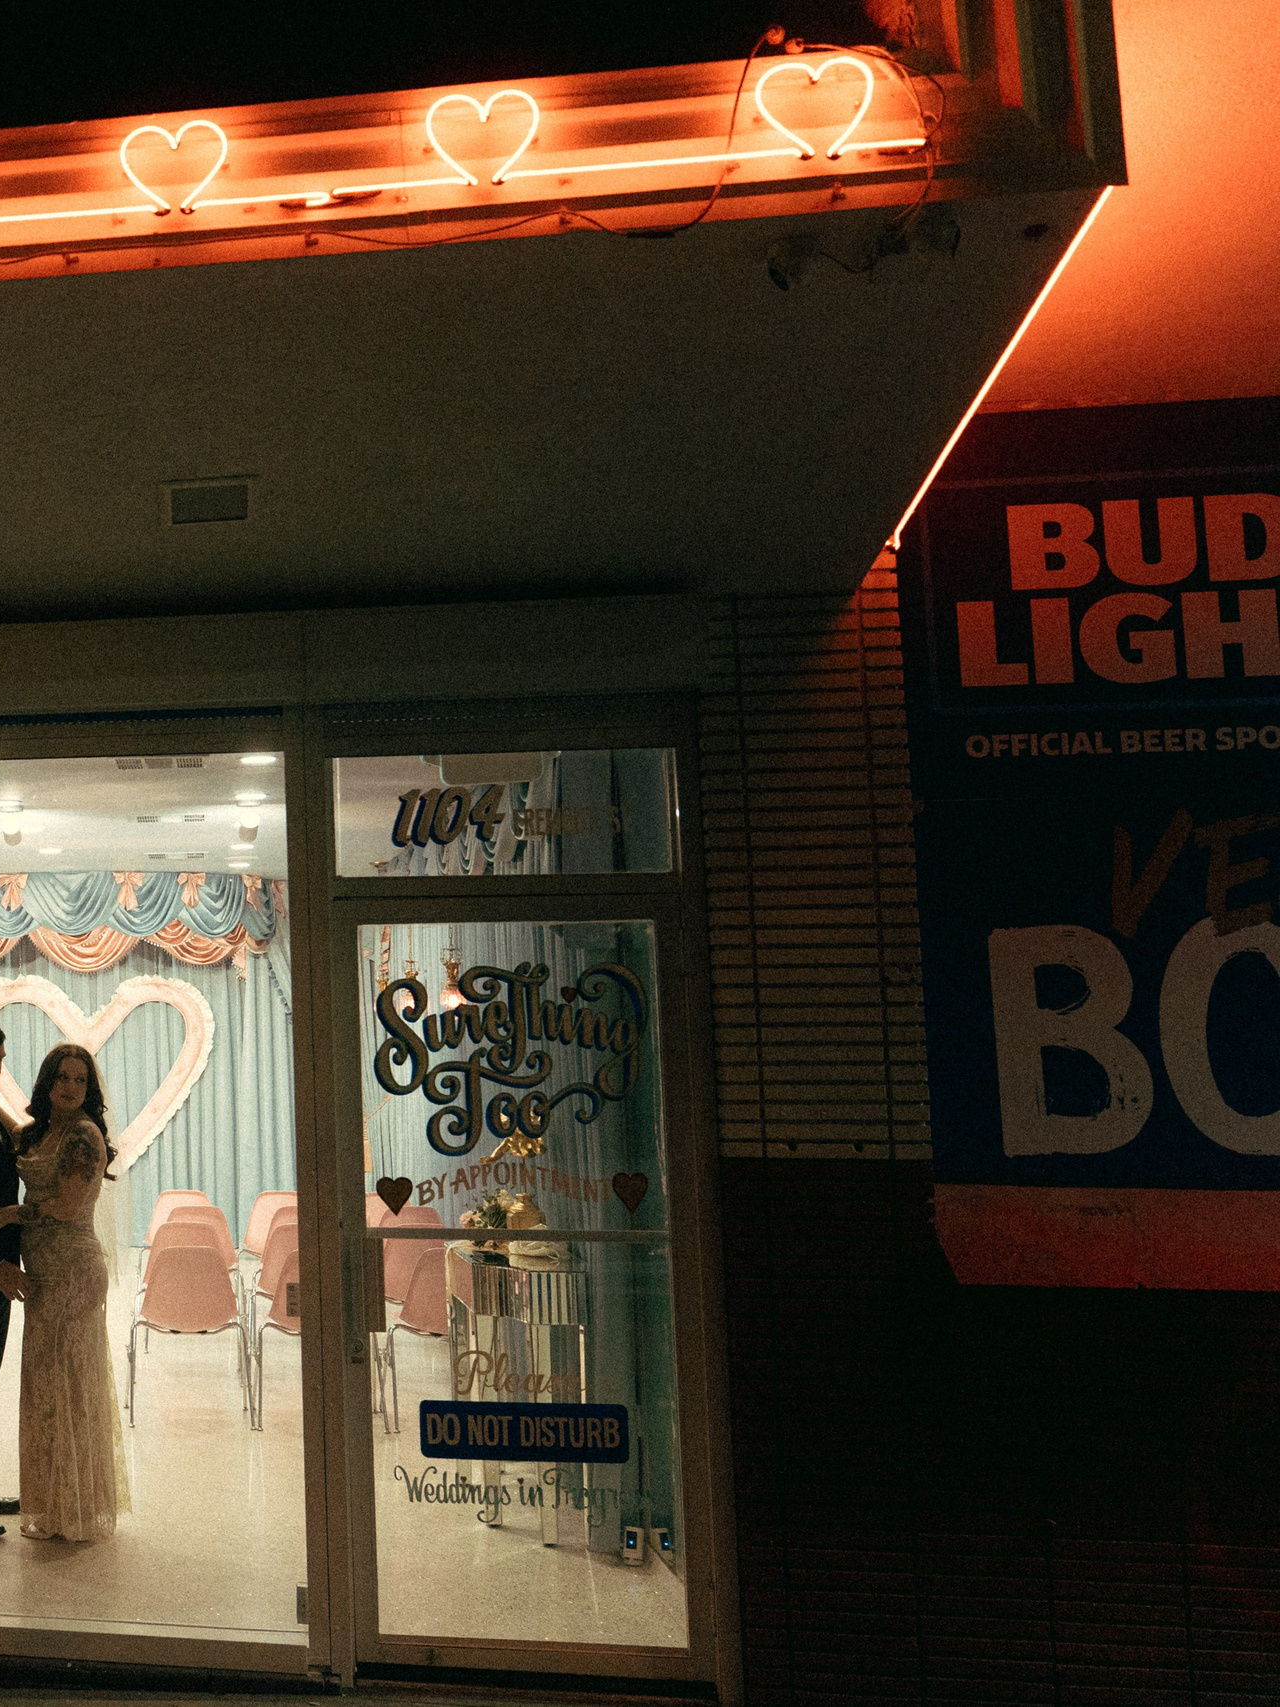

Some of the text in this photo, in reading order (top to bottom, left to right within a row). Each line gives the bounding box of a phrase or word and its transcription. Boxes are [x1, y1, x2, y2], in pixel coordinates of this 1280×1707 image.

[1005, 492, 1280, 592] BUD
[954, 586, 1280, 688] LIGH
[964, 723, 1280, 760] OFFICIAL BEER SPO
[391, 784, 505, 848] 1104
[374, 961, 648, 1102] Sure Thing
[987, 912, 1280, 1159] BO
[422, 1047, 604, 1157] Too
[415, 1162, 611, 1206] BY APPOINTMENT
[452, 1349, 586, 1396] Please
[425, 1412, 622, 1449] DO NOT DISTURB
[392, 1464, 512, 1524] Weddings
[516, 1477, 545, 1508] in
